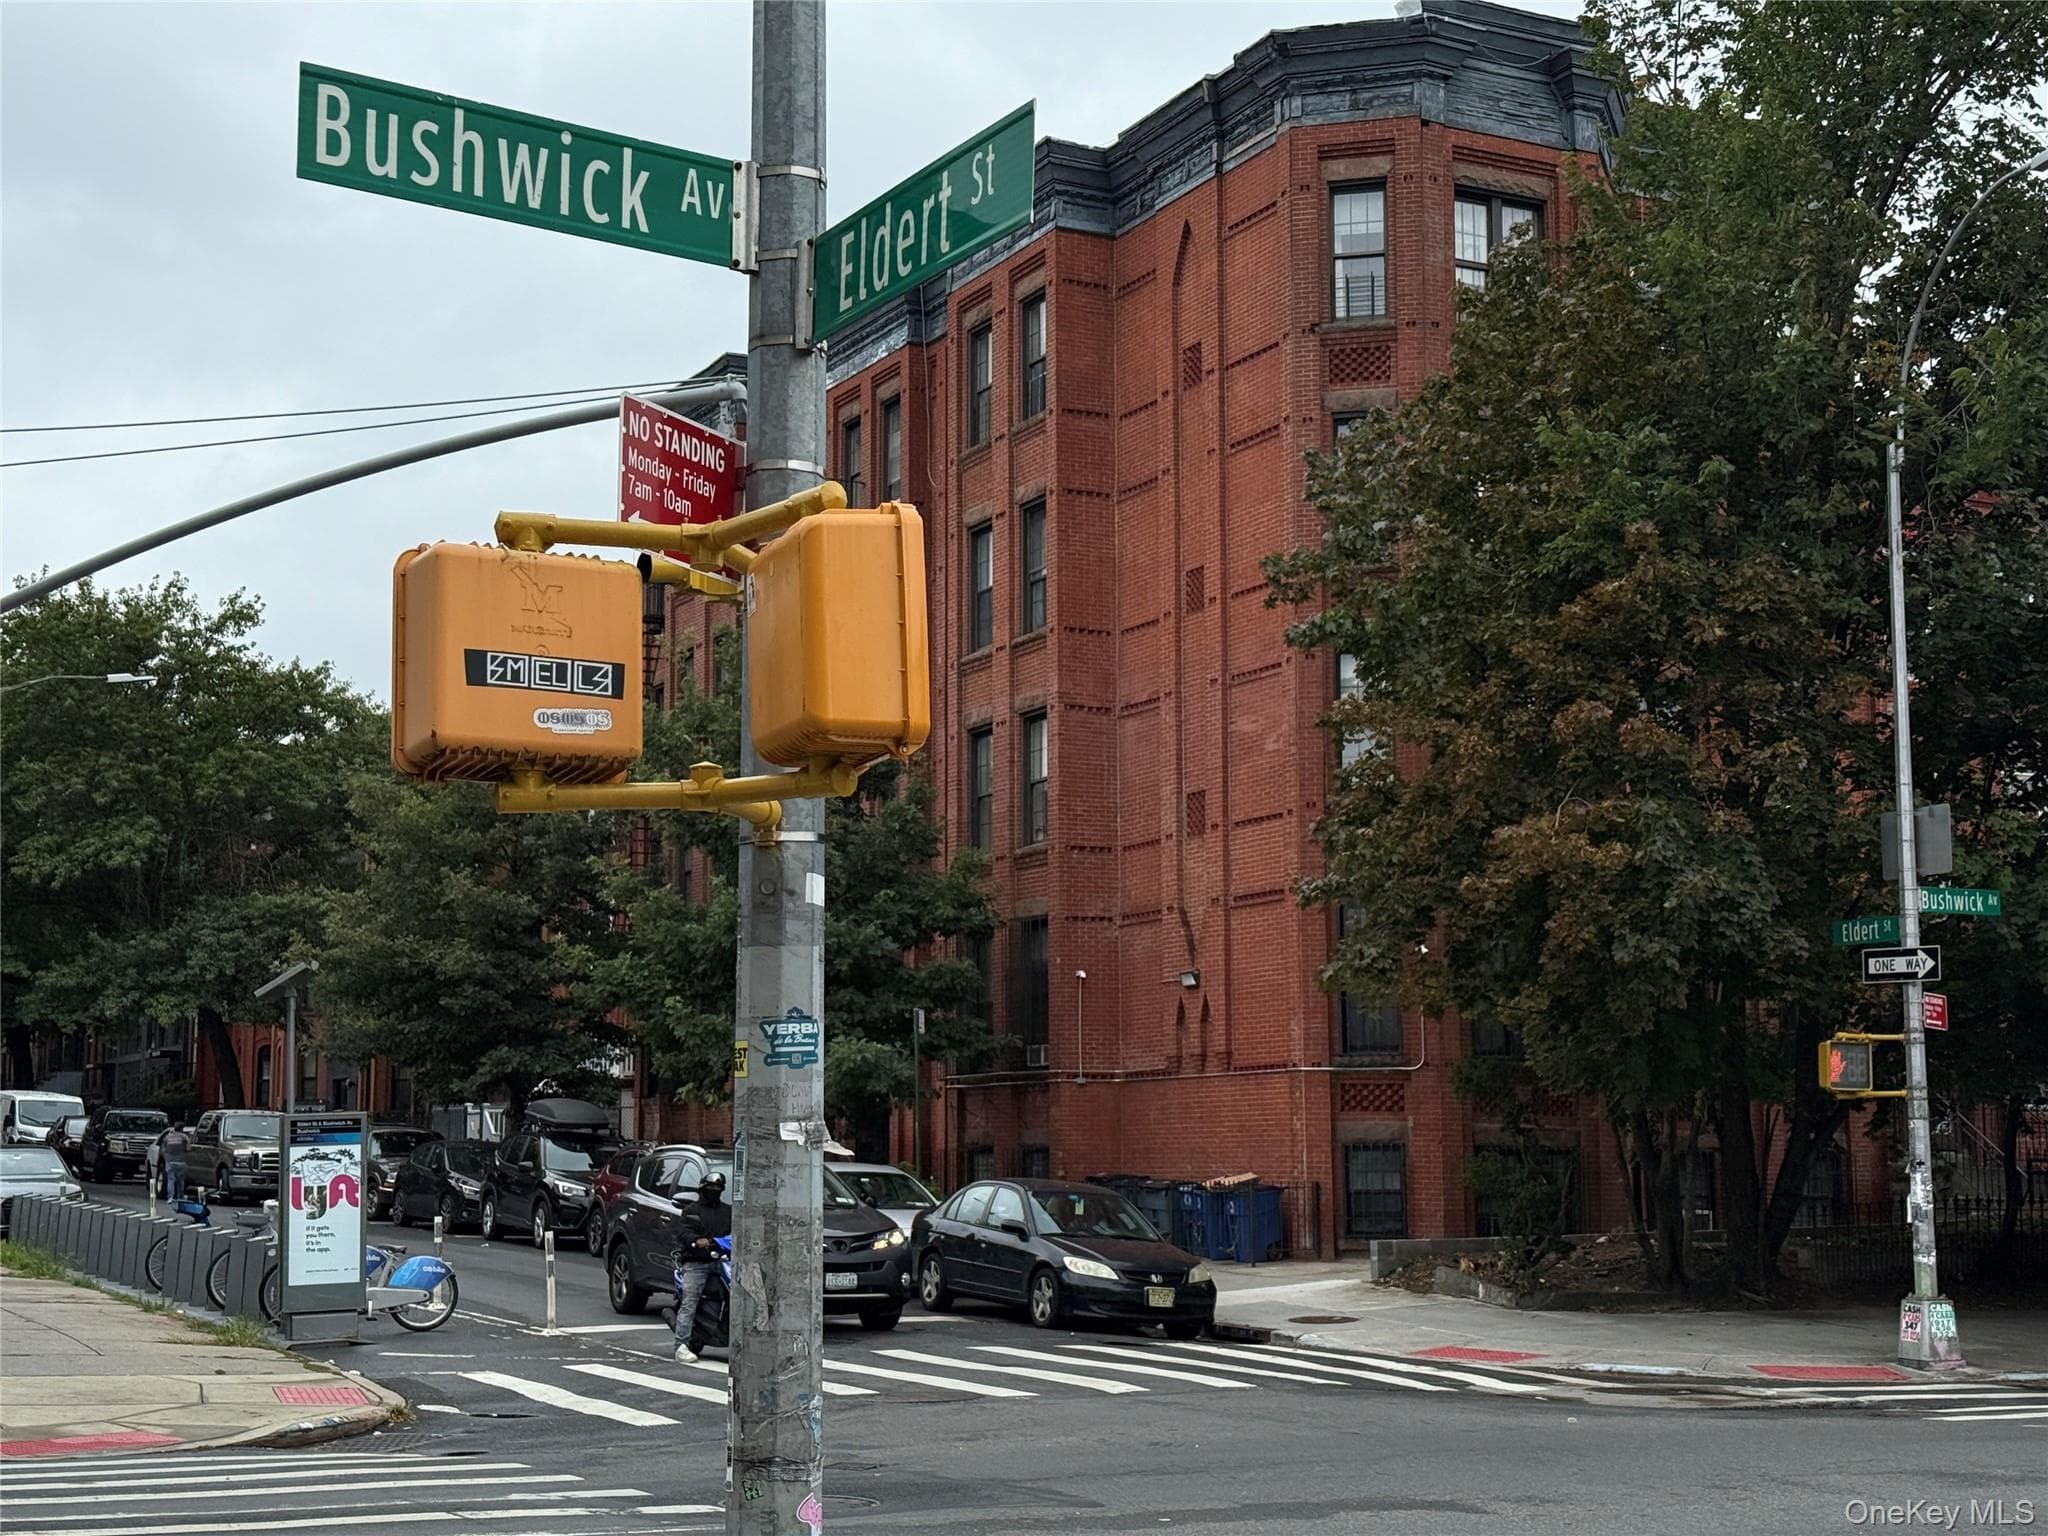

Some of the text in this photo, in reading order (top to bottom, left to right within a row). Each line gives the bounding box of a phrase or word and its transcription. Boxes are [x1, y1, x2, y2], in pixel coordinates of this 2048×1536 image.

[316, 84, 733, 233] Bushwick Av
[839, 144, 995, 313] Eldert St
[629, 411, 725, 473] NO STANDING
[628, 446, 672, 486] Monday
[683, 469, 716, 503] Friday
[628, 474, 652, 502] 7am
[663, 488, 692, 517] 10am
[1921, 890, 1997, 912] Bushwick Av
[1842, 920, 1891, 942] Eldert St
[1874, 958, 1928, 972] ONE WAY
[763, 1022, 818, 1035] YERBA
[291, 1174, 359, 1220] lyft
[1904, 1305, 1921, 1313] CASH
